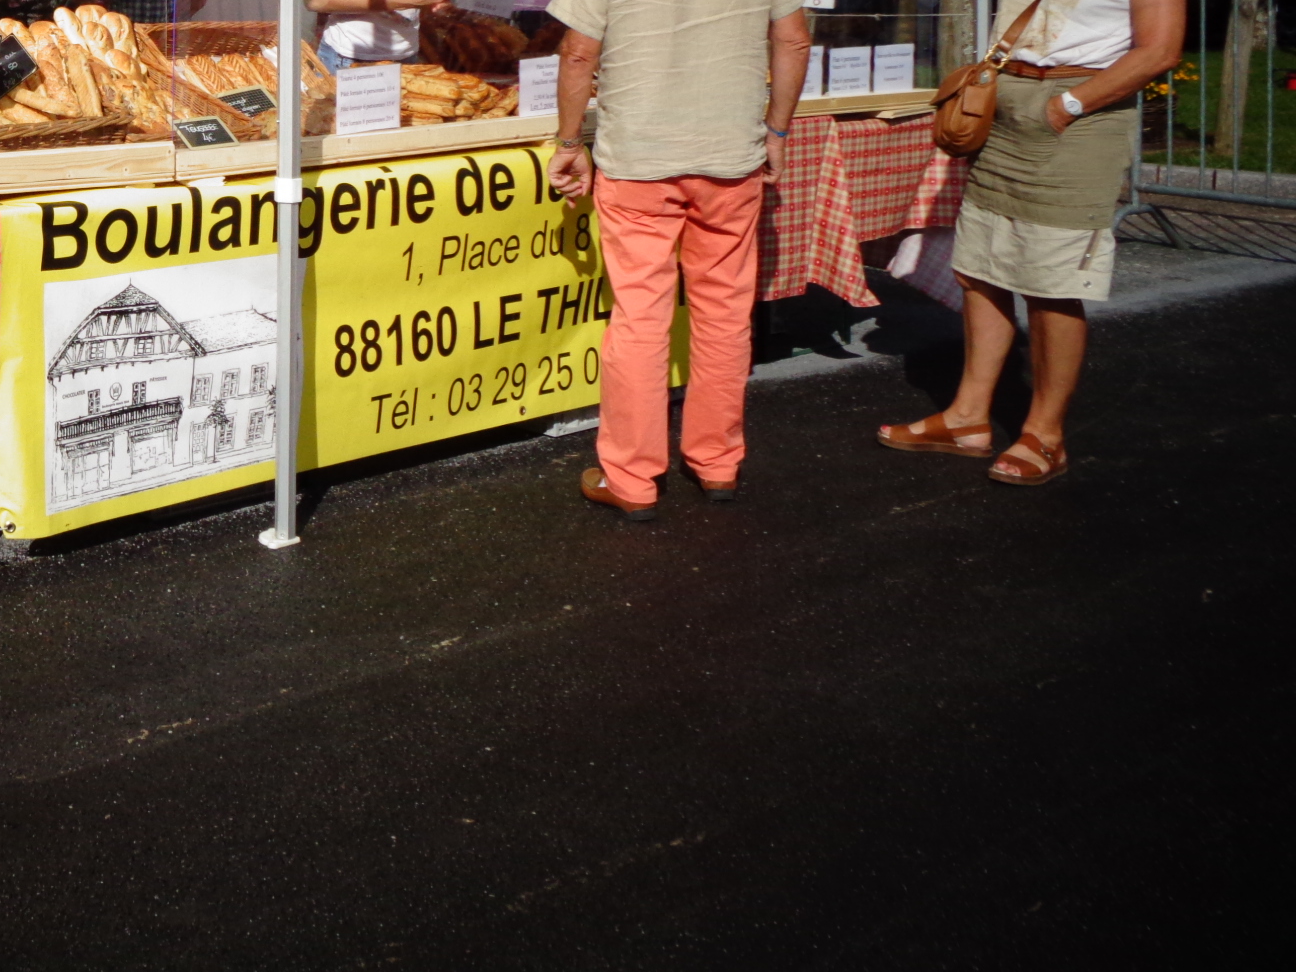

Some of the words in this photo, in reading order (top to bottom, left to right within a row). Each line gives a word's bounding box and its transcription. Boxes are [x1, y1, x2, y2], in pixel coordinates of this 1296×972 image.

[41, 166, 435, 271] Boulangerie
[455, 156, 515, 216] de
[402, 241, 424, 286] 1,
[438, 233, 520, 276] Place
[530, 220, 564, 260] du
[575, 213, 590, 252] 8
[334, 306, 457, 378] 88160
[473, 293, 522, 350] LE
[537, 276, 613, 334] THIL
[370, 387, 419, 434] Tél
[447, 373, 483, 416] 03
[492, 362, 526, 406] 29
[538, 352, 573, 396] 25
[583, 347, 600, 385] 0
